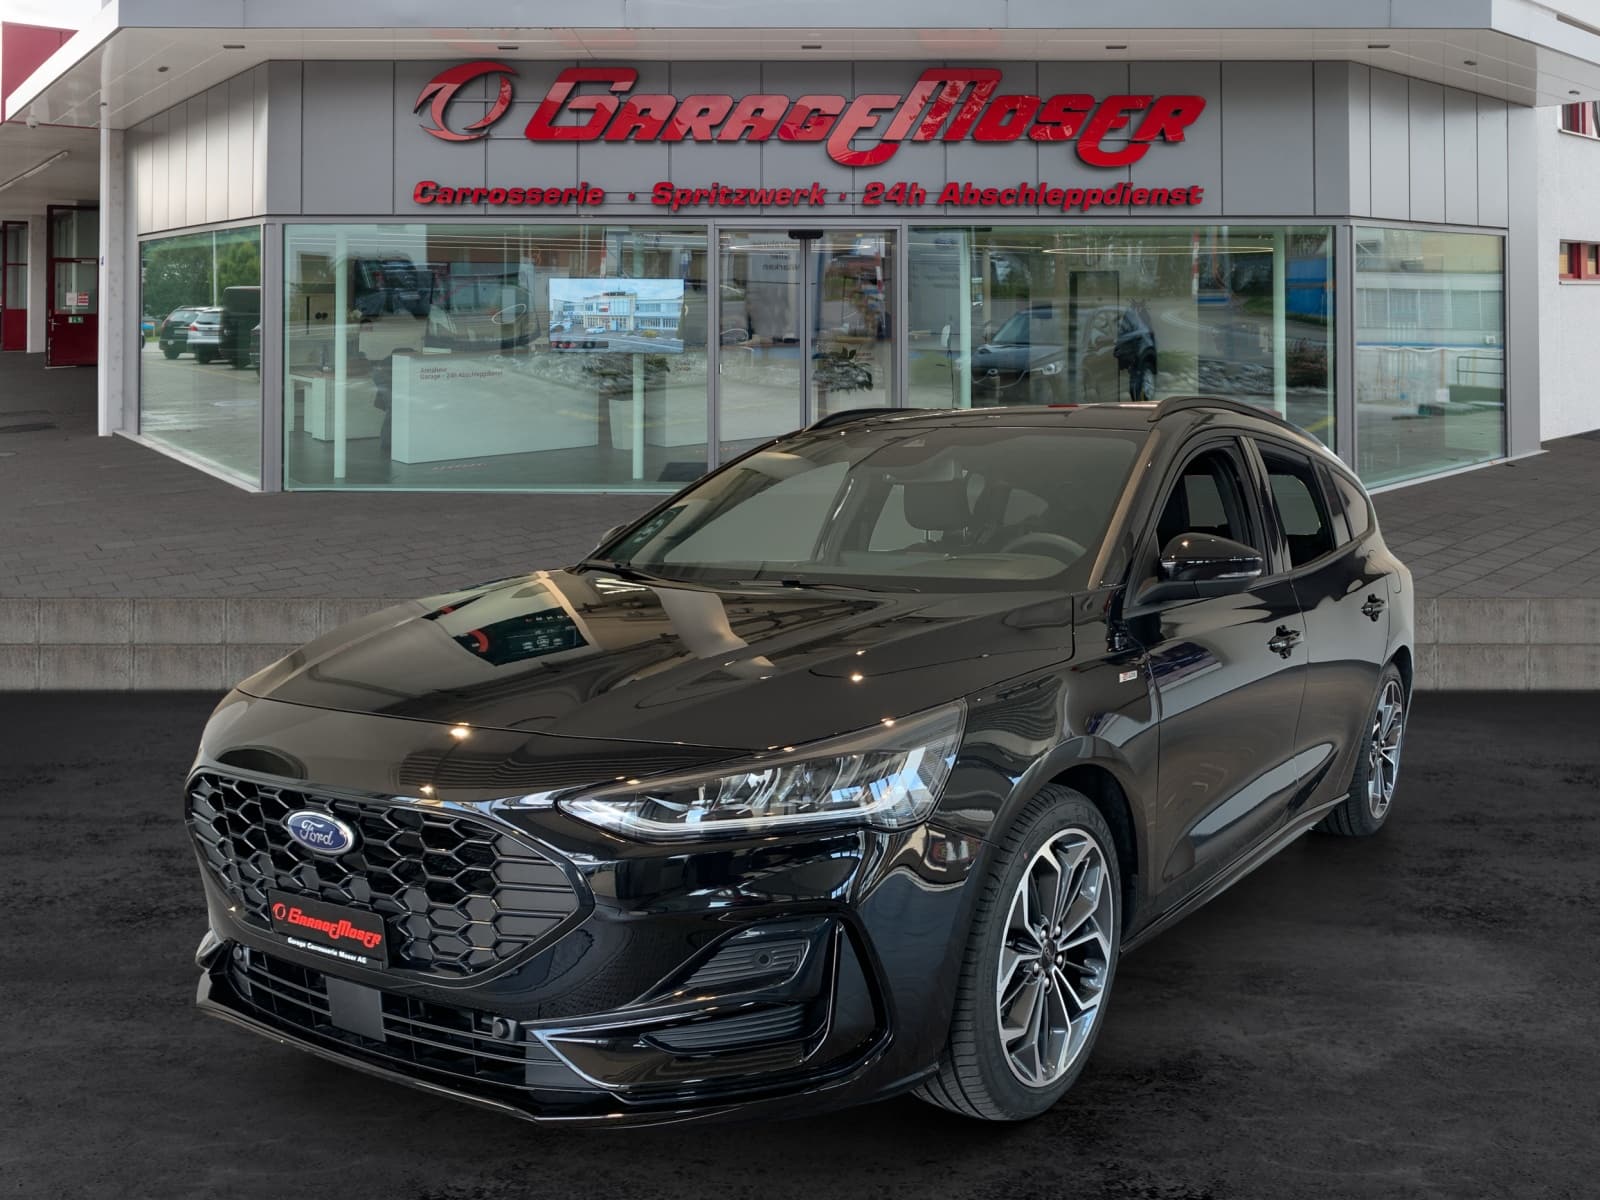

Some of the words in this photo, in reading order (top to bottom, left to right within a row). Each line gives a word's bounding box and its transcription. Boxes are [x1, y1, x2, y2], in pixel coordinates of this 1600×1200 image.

[413, 181, 605, 206] Carrosserie
[650, 181, 827, 211] Spritzwerk
[863, 181, 927, 206] 24h
[938, 181, 1205, 212] Abschleppdienst
[299, 819, 334, 846] Ford
[287, 936, 306, 948] Garage
[357, 955, 367, 964] AG
